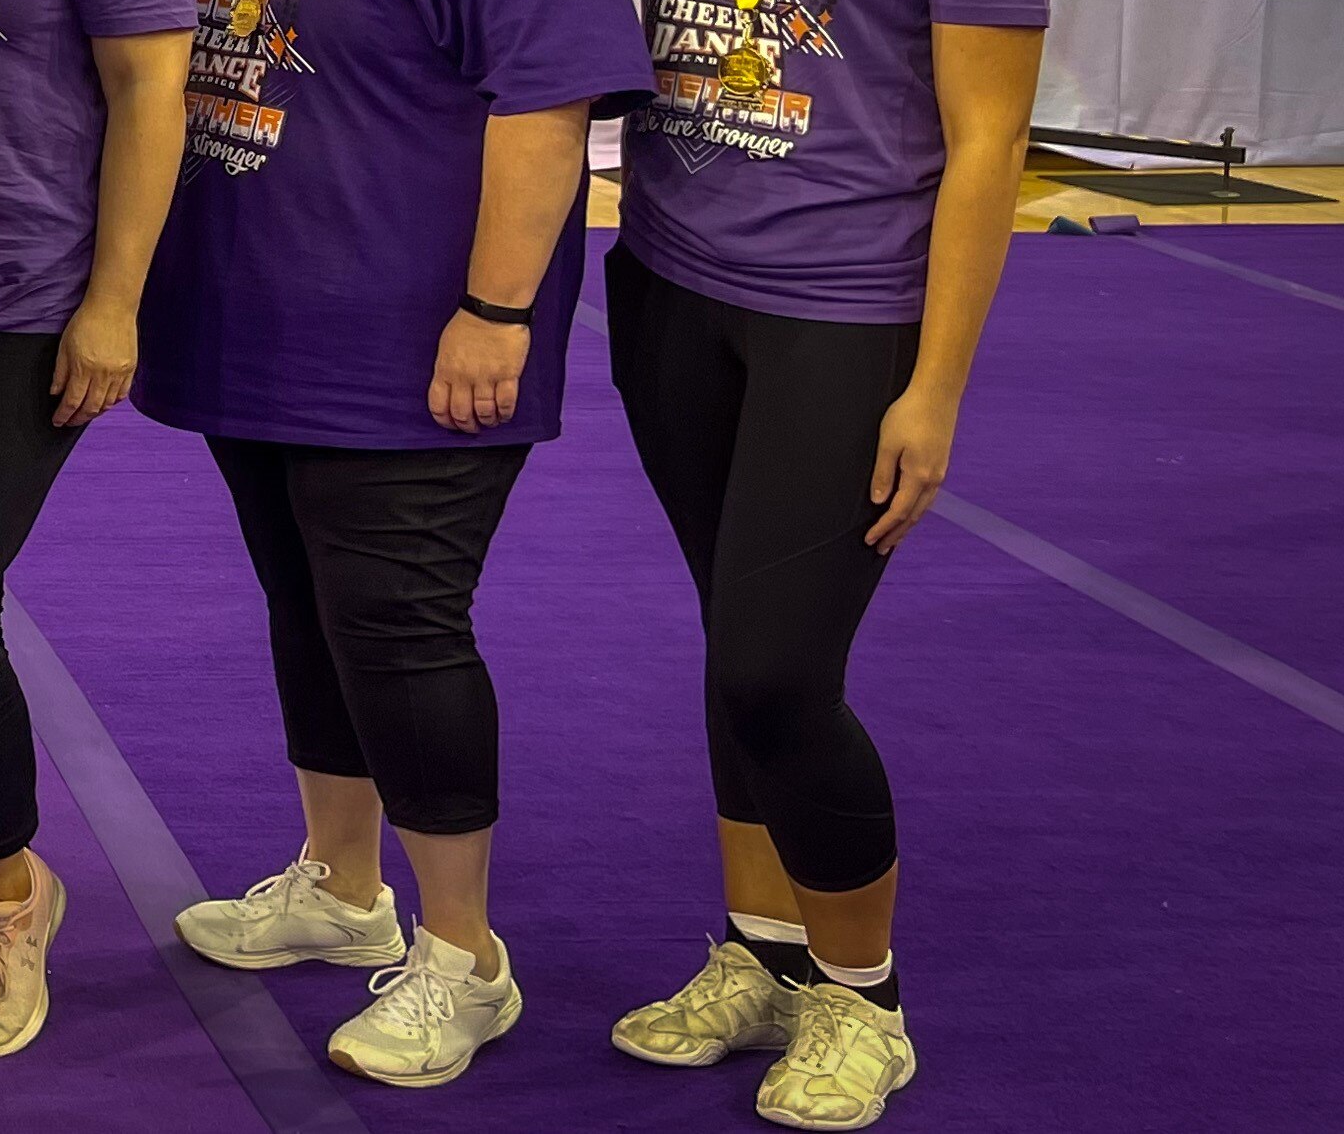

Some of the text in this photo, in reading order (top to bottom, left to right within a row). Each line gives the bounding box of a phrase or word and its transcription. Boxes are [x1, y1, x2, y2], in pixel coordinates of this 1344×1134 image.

[762, 14, 780, 36] N
[190, 49, 267, 102] ANCE
[653, 22, 782, 88] DANE
[670, 53, 718, 65] BEND
[189, 74, 236, 90] ENDIGO
[185, 91, 286, 148] ETHER
[662, 118, 697, 138] are
[702, 120, 794, 160] stronger
[193, 133, 267, 176] stronger
